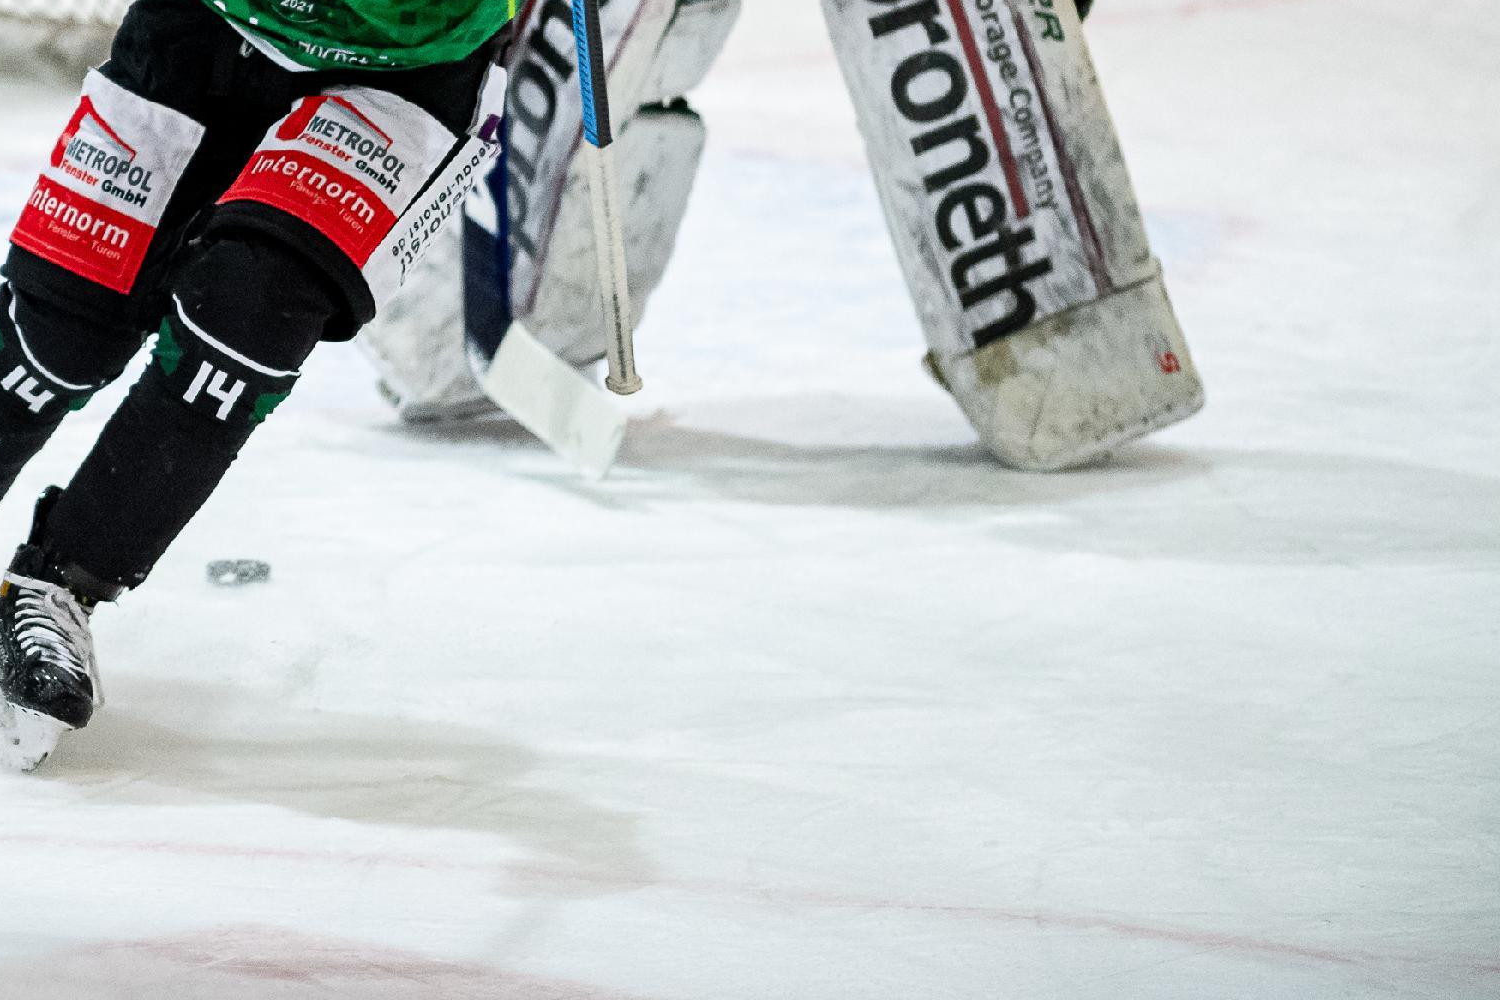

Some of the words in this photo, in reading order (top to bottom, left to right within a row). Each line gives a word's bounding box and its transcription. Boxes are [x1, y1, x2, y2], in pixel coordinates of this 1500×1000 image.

[66, 137, 152, 193] METROPOL
[297, 132, 353, 162] Fenster
[355, 159, 398, 195] GmbH
[307, 115, 405, 182] METROPOL
[1009, 88, 1057, 211] Company
[61, 159, 99, 187] Fenster
[101, 179, 148, 208] GmbH
[251, 155, 376, 225] Internorm
[29, 187, 130, 249] nternorm
[0, 365, 56, 413] 14
[182, 360, 246, 421] 14
